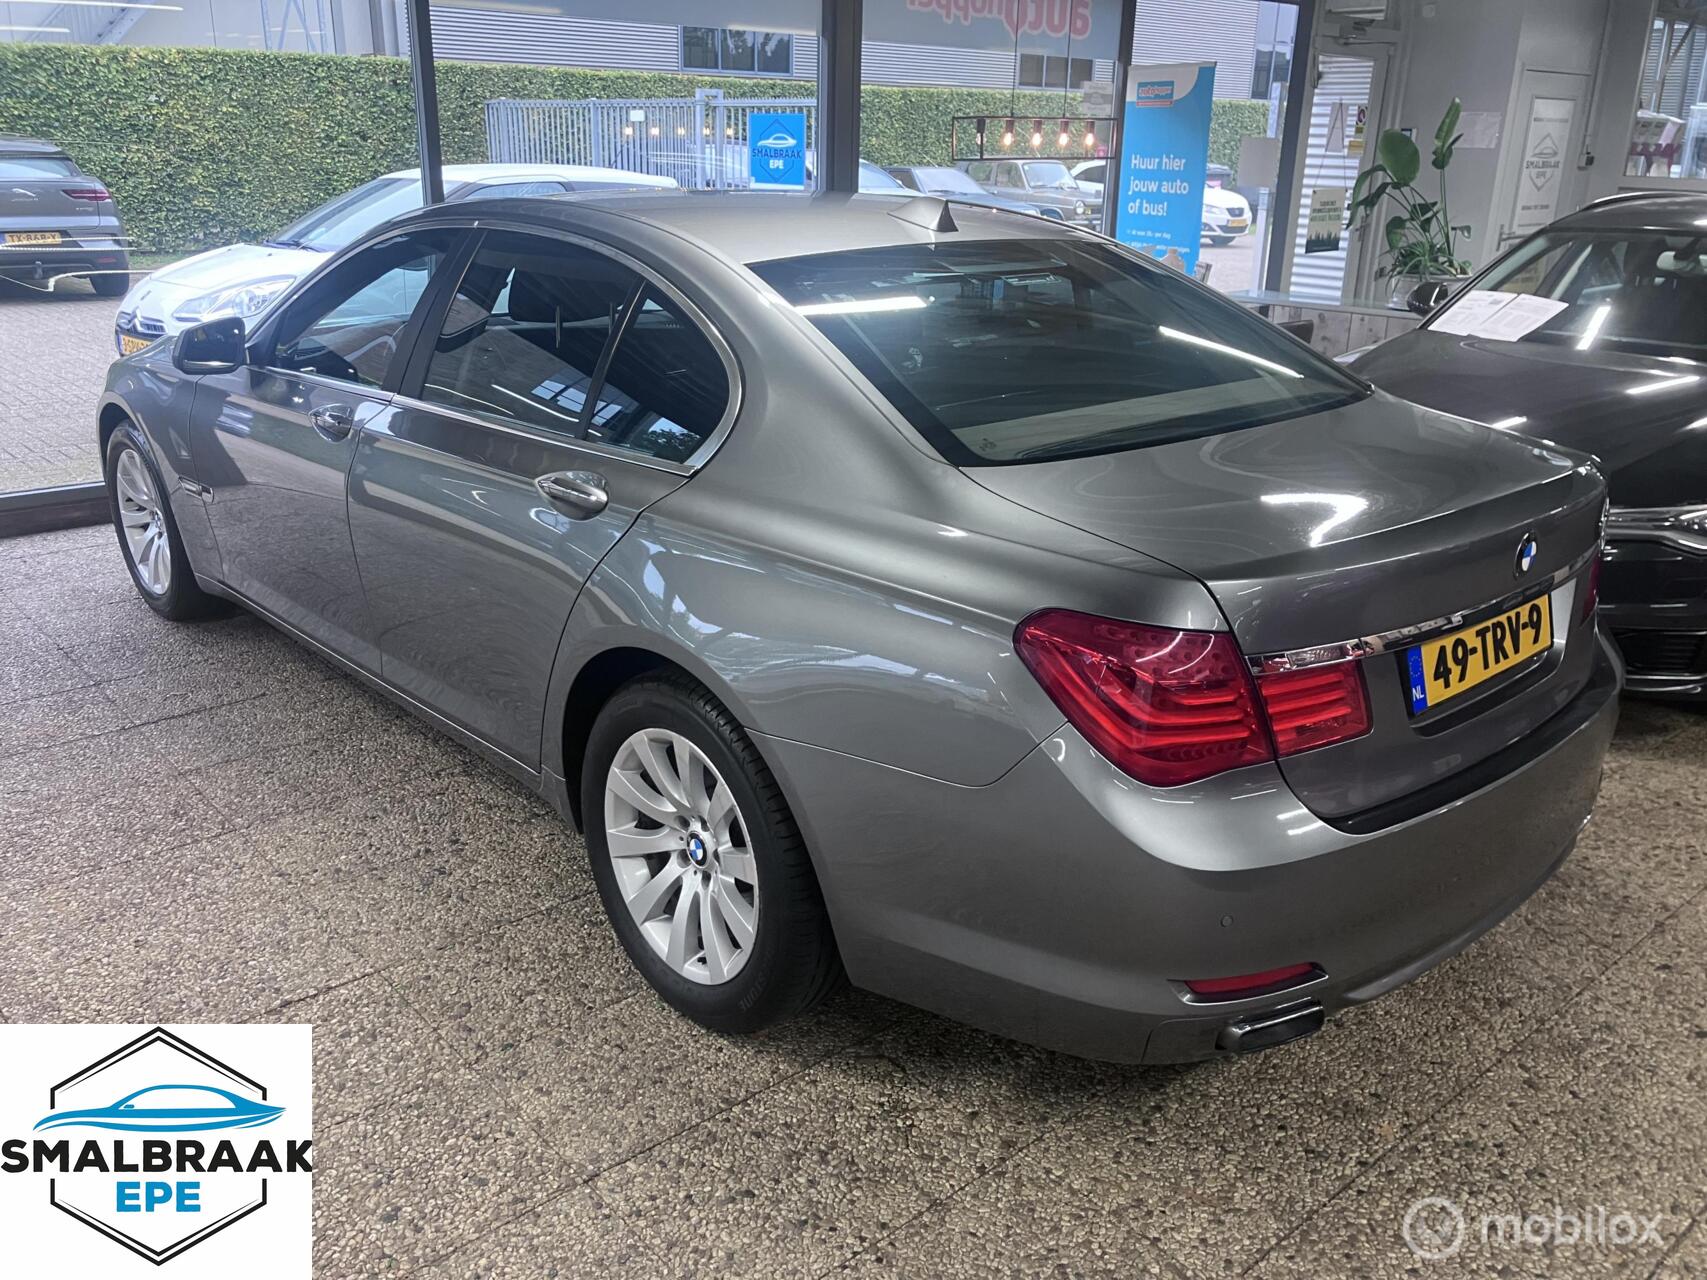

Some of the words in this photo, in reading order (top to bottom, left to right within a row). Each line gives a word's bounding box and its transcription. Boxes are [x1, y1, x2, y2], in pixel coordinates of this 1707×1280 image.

[752, 148, 802, 159] SMALBRAAK
[769, 160, 784, 169] EPE
[1131, 154, 1159, 169] Huur
[1162, 154, 1186, 171] hier
[1128, 176, 1158, 195] jouw
[1161, 179, 1189, 194] auto
[1128, 198, 1141, 214] of
[1142, 200, 1168, 216] bus!
[1433, 603, 1543, 689] 49-TRV-9
[1412, 686, 1424, 701] NL
